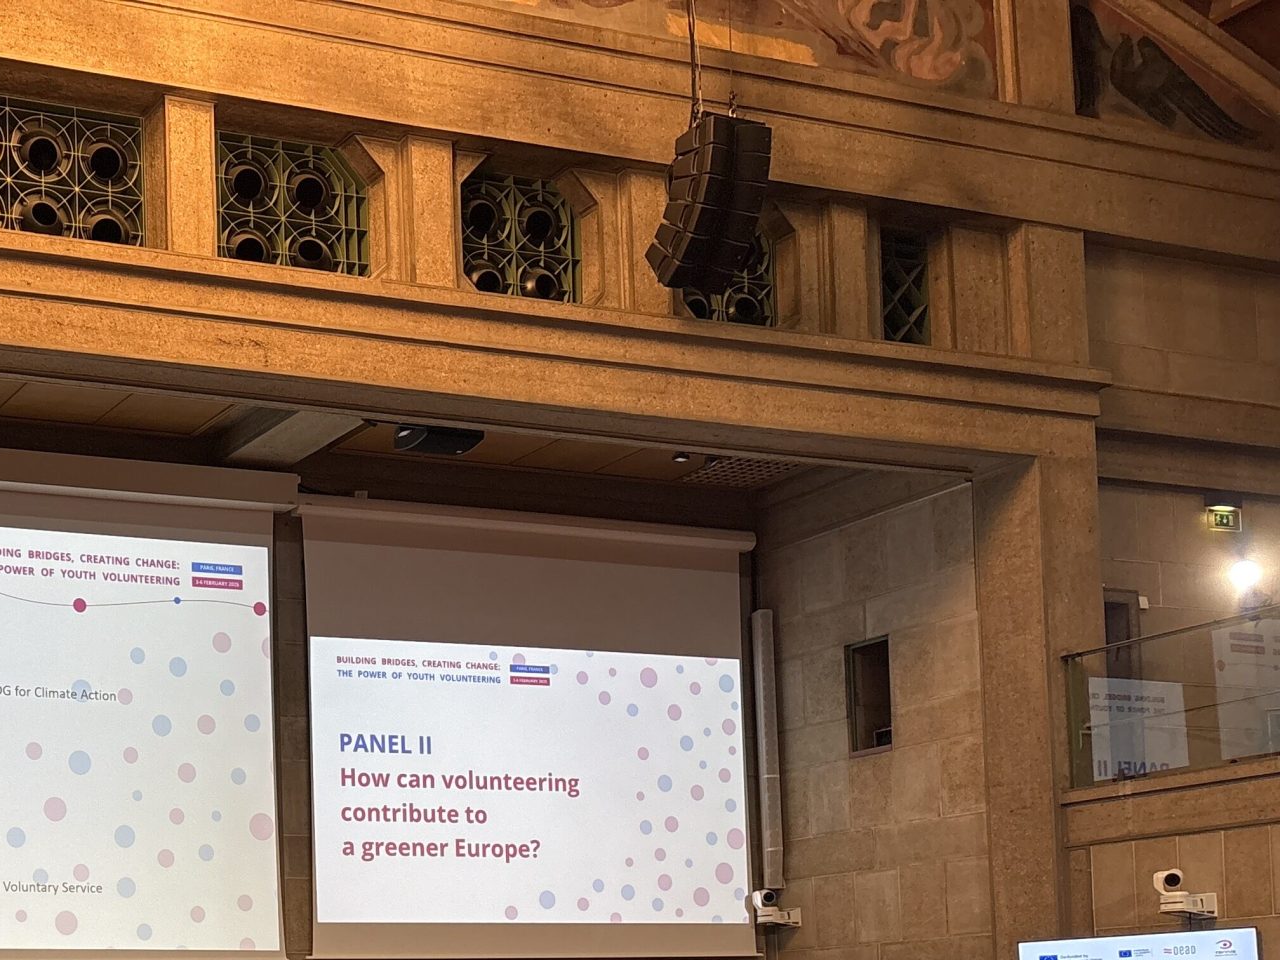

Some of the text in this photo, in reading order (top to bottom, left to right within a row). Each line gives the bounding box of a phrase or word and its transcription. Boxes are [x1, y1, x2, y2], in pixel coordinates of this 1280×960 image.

[28, 550, 74, 563] BRIDGES,
[80, 554, 129, 566] CREATING
[136, 558, 179, 569] CHANGE:
[41, 568, 54, 577] OF
[61, 569, 96, 580] YOUTH
[103, 572, 180, 586] VOLUNTEERING
[337, 656, 500, 670] BUILDING BRIDGES, CREATING CHANGE:
[407, 672, 435, 680] YOUTH
[440, 674, 500, 683] VOLUNTEERING
[15, 686, 31, 696] for
[35, 683, 77, 699] Climate
[80, 689, 116, 701] Action
[340, 734, 431, 754] PANEL II
[341, 768, 579, 797] How can volunteering
[341, 803, 487, 824] contribute to
[343, 839, 540, 863] a greener Europe?
[3, 878, 59, 895] Voluntary
[62, 882, 102, 893] Service
